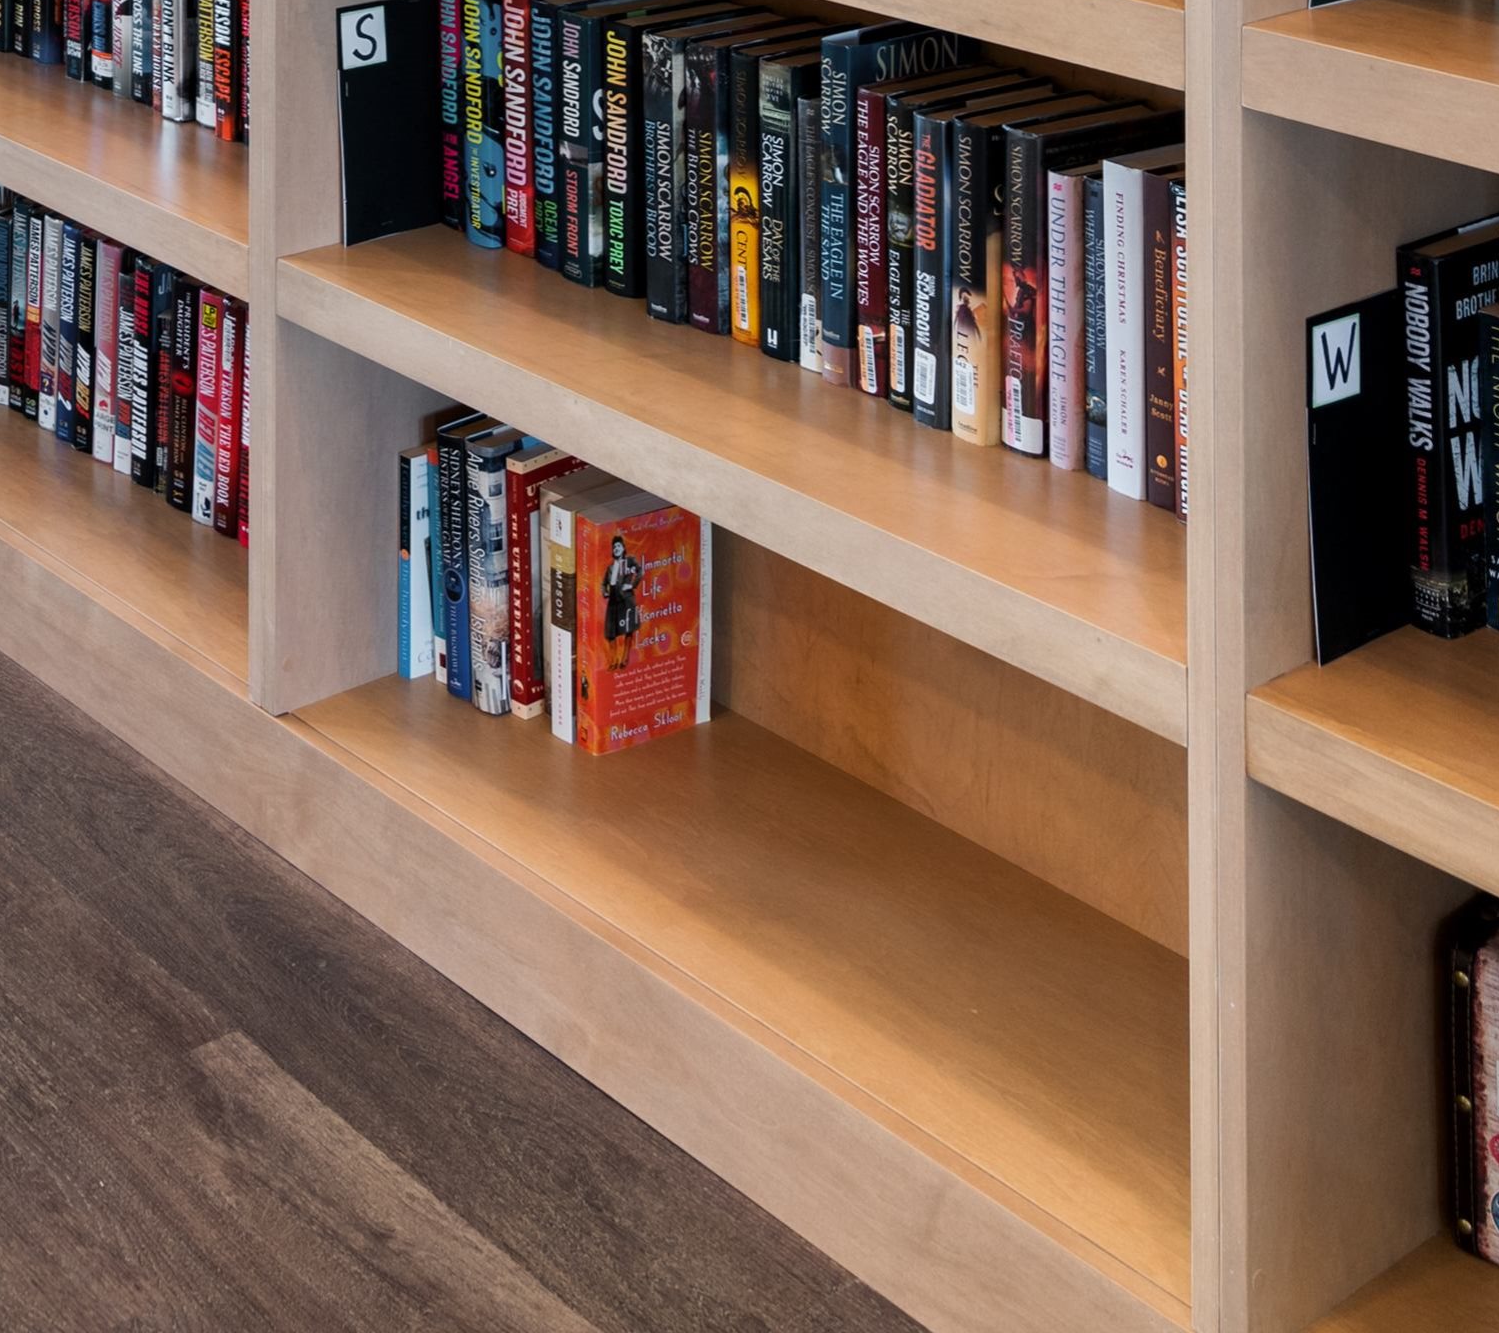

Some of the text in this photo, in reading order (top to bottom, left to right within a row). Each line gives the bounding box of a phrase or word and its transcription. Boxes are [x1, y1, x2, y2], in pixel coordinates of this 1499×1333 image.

[215, 47, 231, 103] ESCAPE
[352, 13, 377, 61] S
[606, 30, 628, 275] JOHN SANDFORD TOXIC PREY
[916, 150, 936, 251] GLADIATOR
[1049, 197, 1065, 393] UNDER THE EAGLE
[1321, 323, 1355, 389] W
[1404, 282, 1433, 451] NOBODY WALKS
[468, 488, 486, 671] Rivers Siddons Islands
[511, 547, 523, 665] UTE INDIANS
[610, 723, 648, 741] Rebecca
